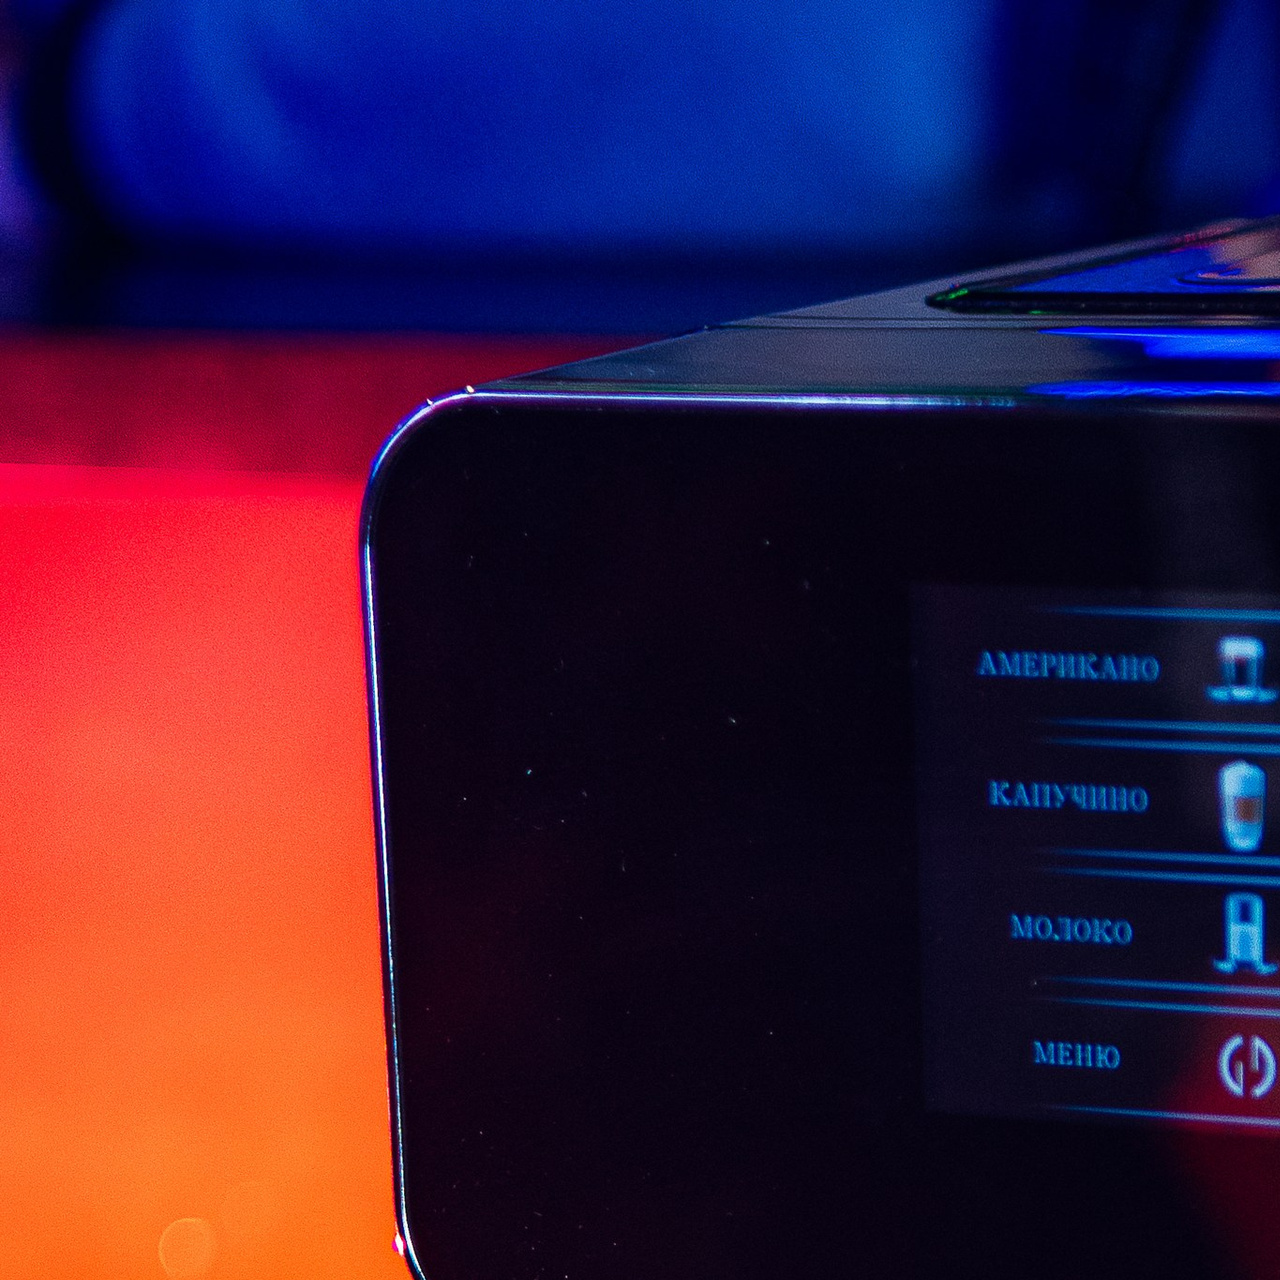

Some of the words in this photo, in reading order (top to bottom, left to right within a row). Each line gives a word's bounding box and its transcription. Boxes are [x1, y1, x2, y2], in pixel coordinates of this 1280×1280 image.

[977, 651, 1161, 682] АМЕРИКАНО
[988, 780, 1150, 812] КАПУЧИНО
[1010, 914, 1133, 945] МОЛОКО
[1032, 1040, 1121, 1069] МЕНЮ
